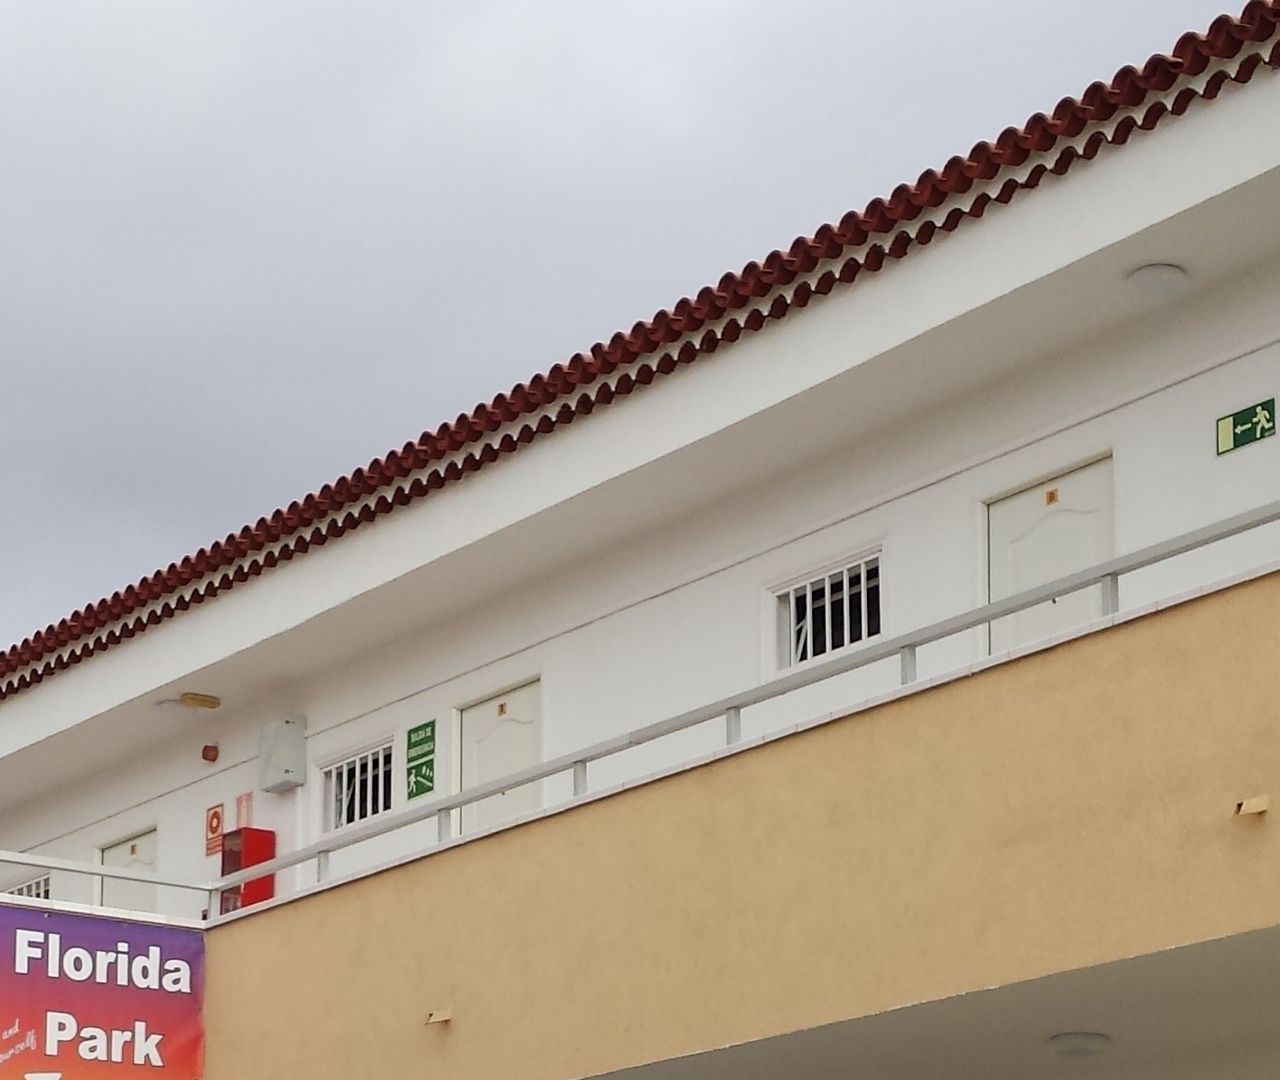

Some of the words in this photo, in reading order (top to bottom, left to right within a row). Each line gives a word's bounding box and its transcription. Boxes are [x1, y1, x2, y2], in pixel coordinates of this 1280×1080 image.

[14, 928, 193, 994] Florida
[2, 1018, 20, 1040] and
[45, 1009, 165, 1068] Park
